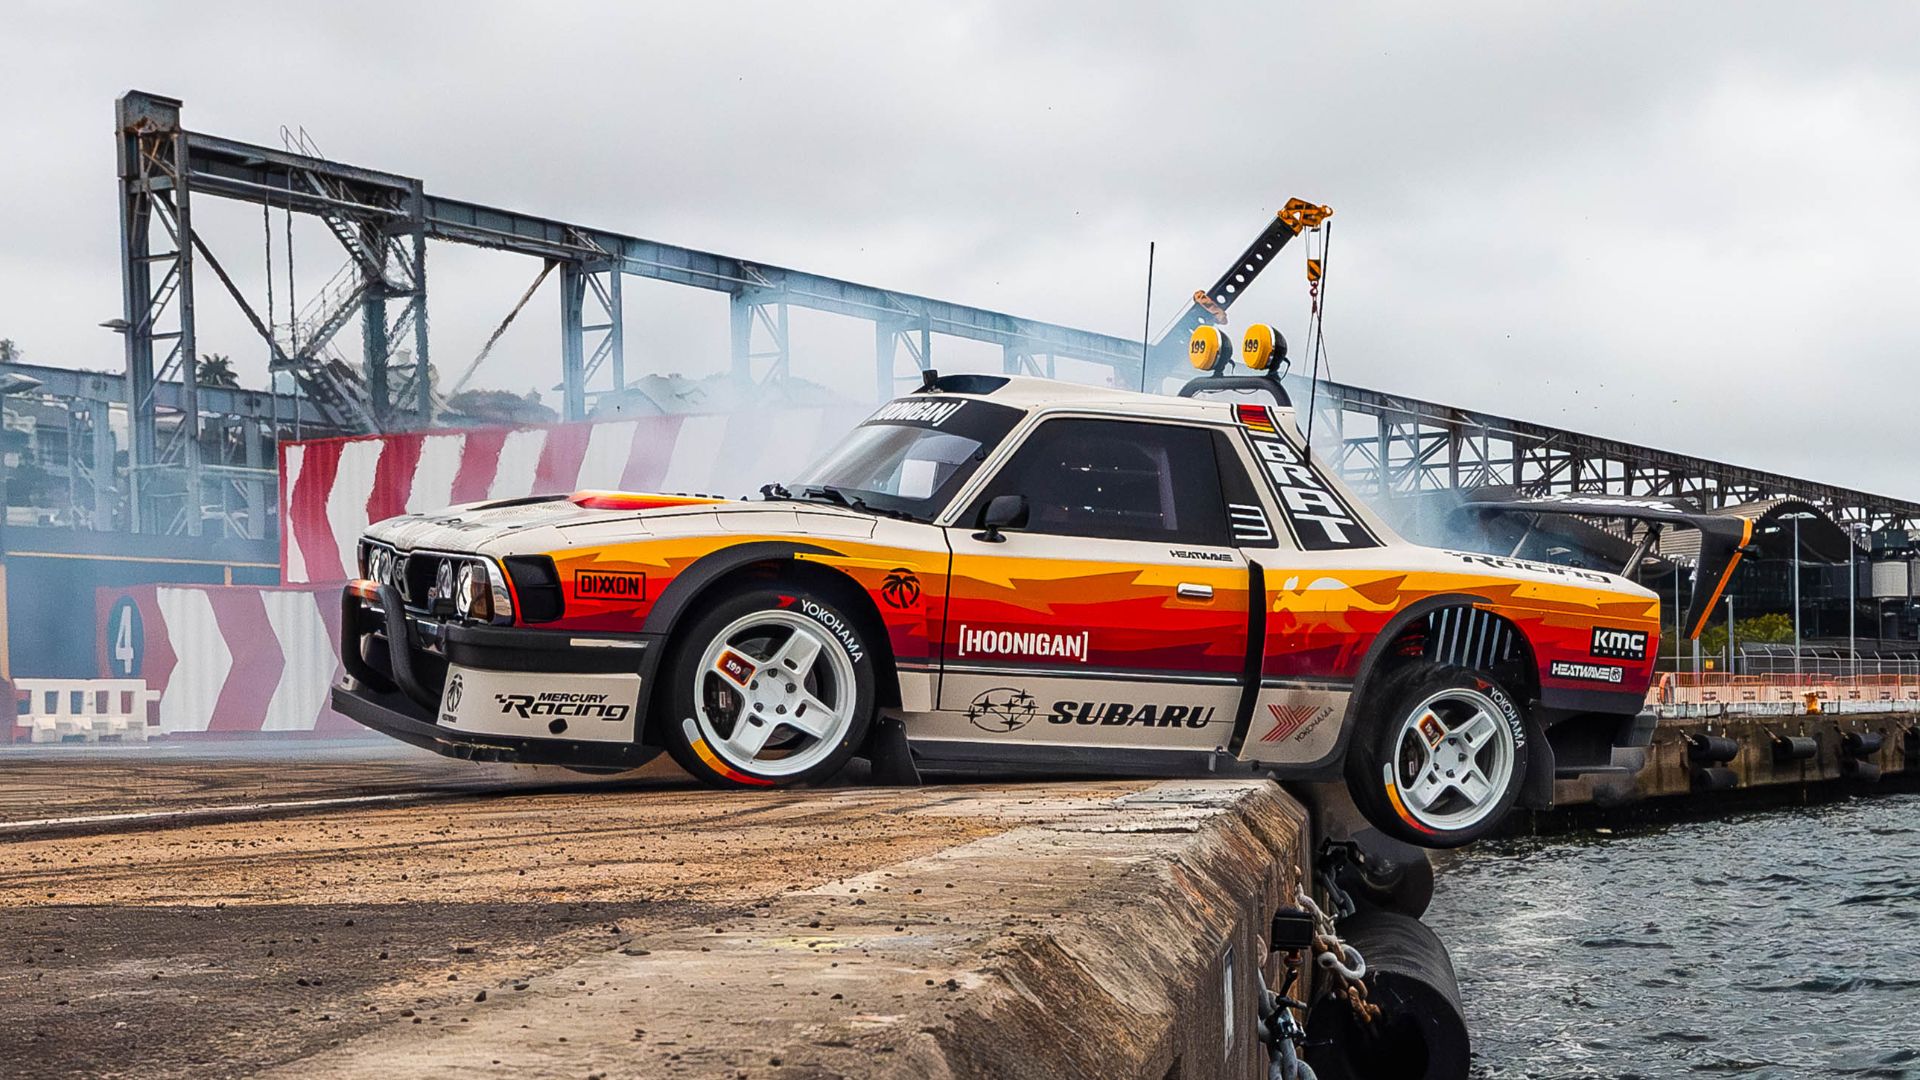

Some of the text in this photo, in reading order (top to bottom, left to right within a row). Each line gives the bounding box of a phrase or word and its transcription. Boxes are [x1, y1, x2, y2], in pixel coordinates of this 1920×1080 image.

[1191, 340, 1206, 353] 199
[1244, 339, 1259, 352] 199
[1253, 440, 1354, 543] BRAT
[581, 575, 639, 595] DIXXON
[115, 605, 134, 674] 4
[801, 599, 863, 663] YOKOHAMA
[958, 624, 1088, 662] [HOONIGAN]
[726, 660, 742, 675] 199
[1551, 662, 1611, 680] HEATWAVE
[495, 693, 630, 722] Racing
[538, 692, 608, 704] MERCURY
[1047, 701, 1215, 729] SUBARU
[1489, 687, 1525, 749] YOKOHAMA
